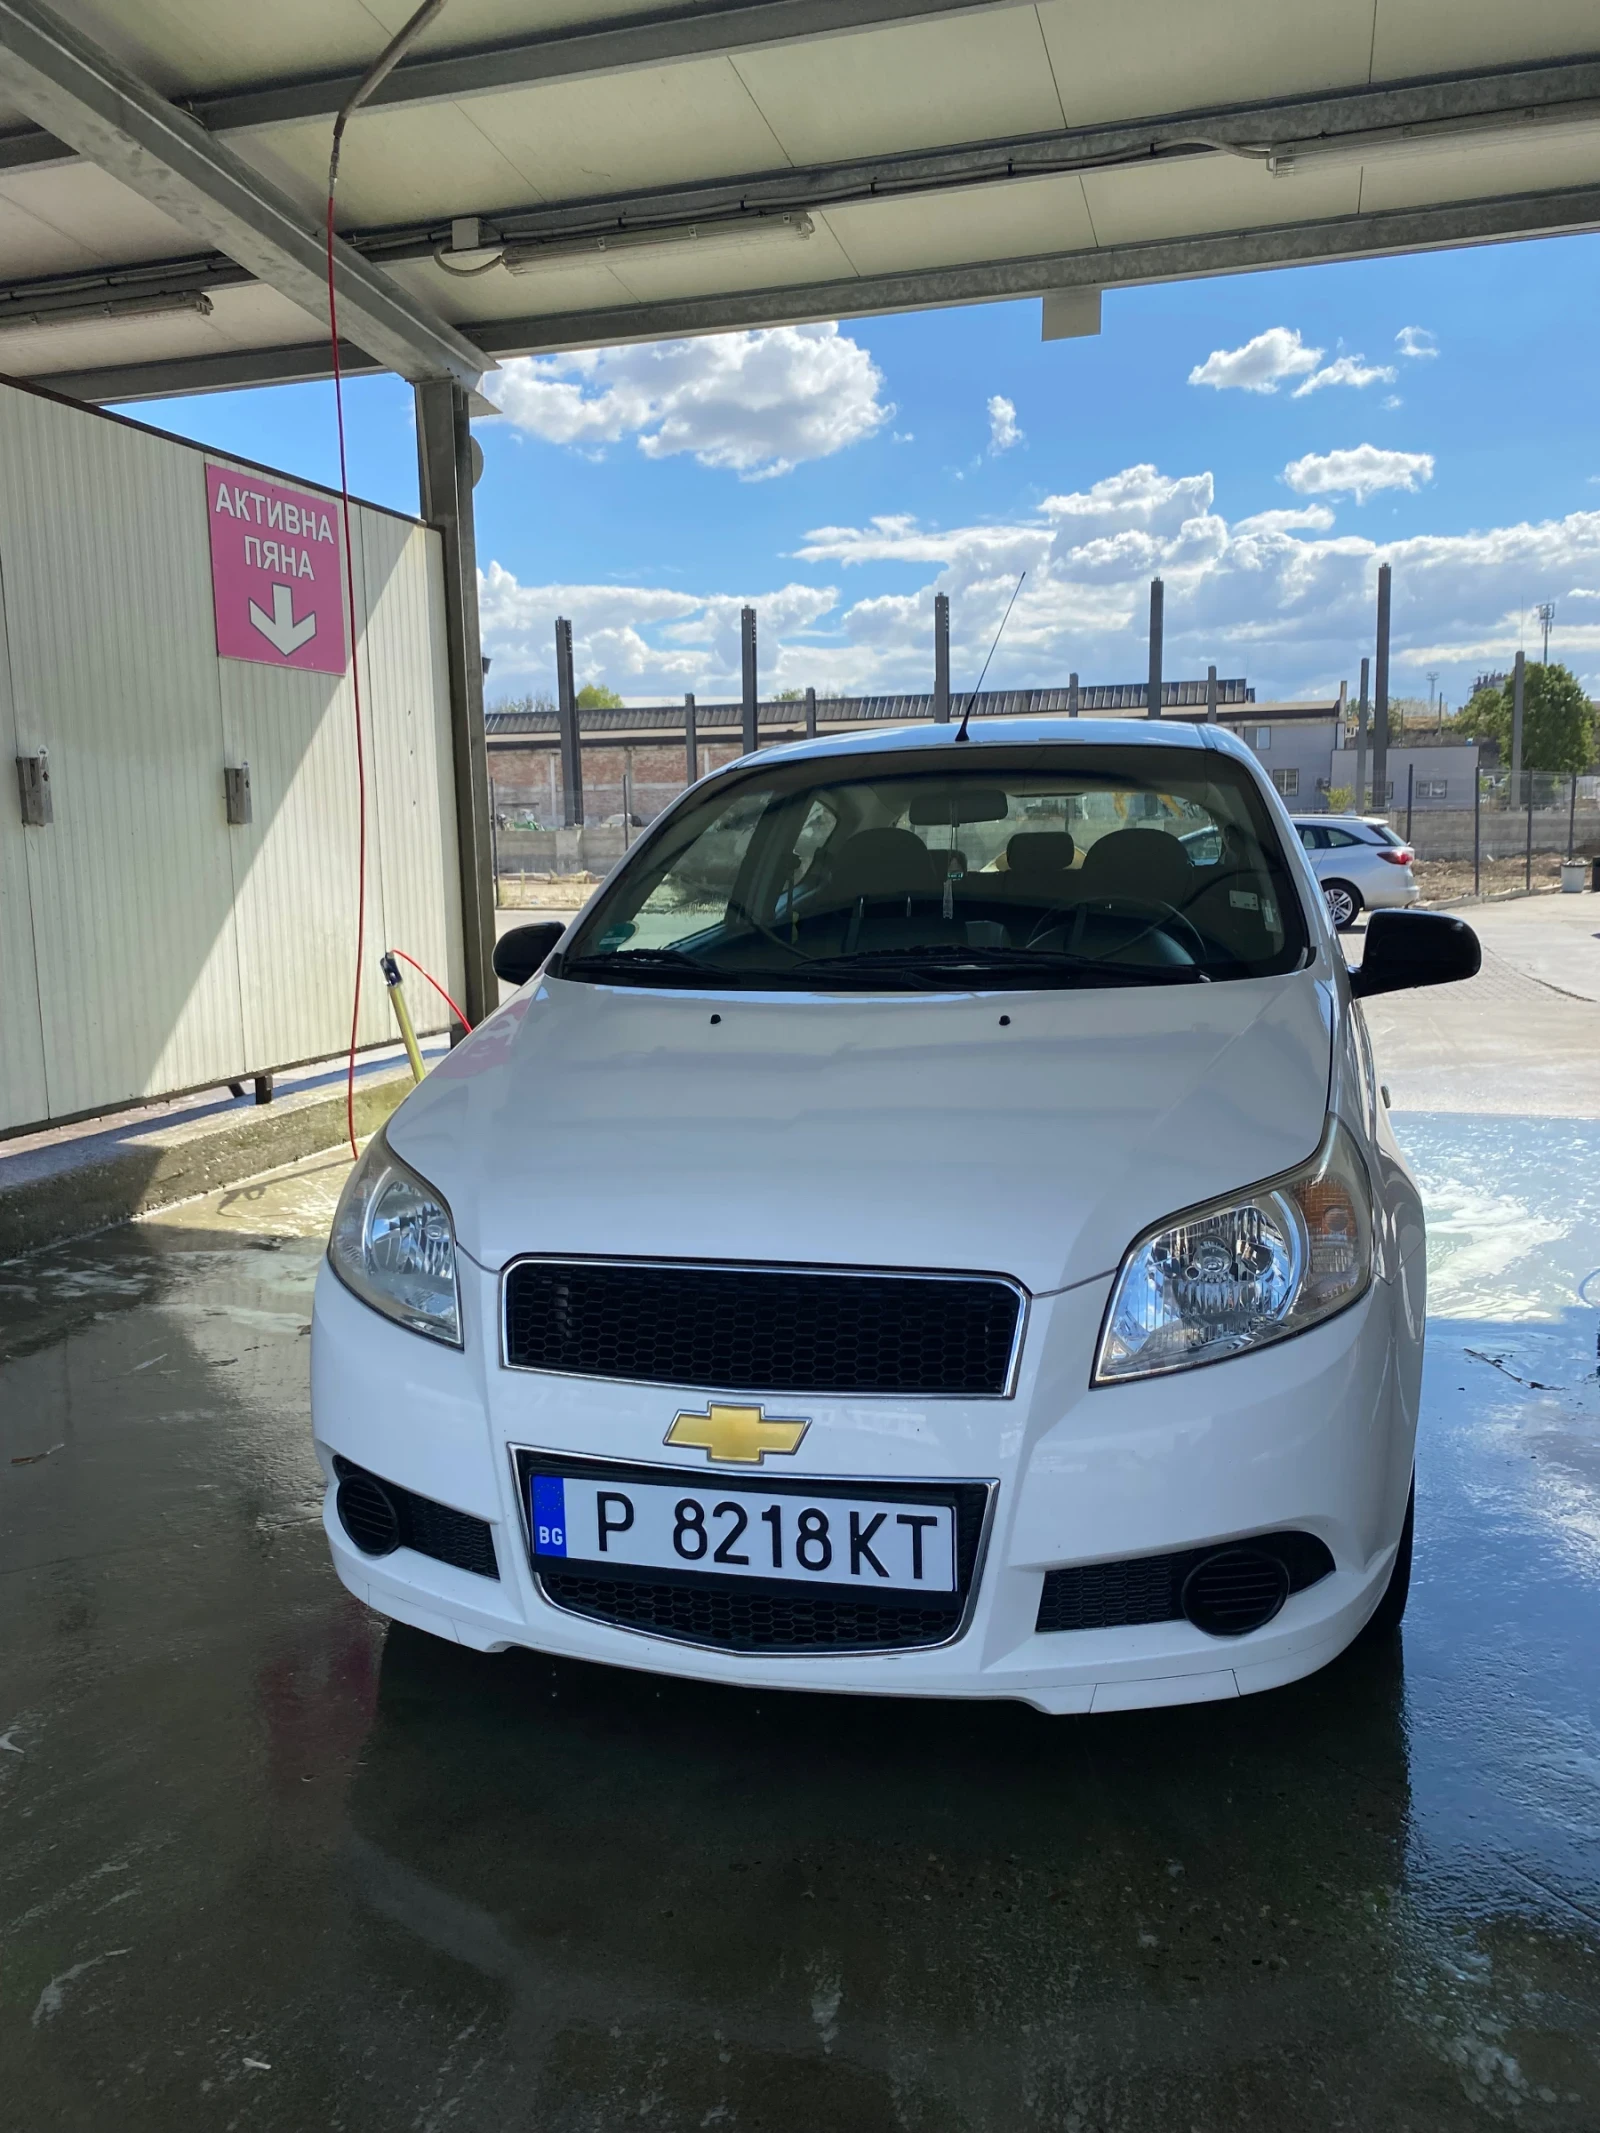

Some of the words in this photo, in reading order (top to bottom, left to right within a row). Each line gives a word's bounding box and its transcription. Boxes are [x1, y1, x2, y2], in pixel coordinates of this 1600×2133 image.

[215, 482, 334, 544] АКТИВНА
[244, 535, 315, 581] ПЯНА
[538, 1525, 564, 1546] BG
